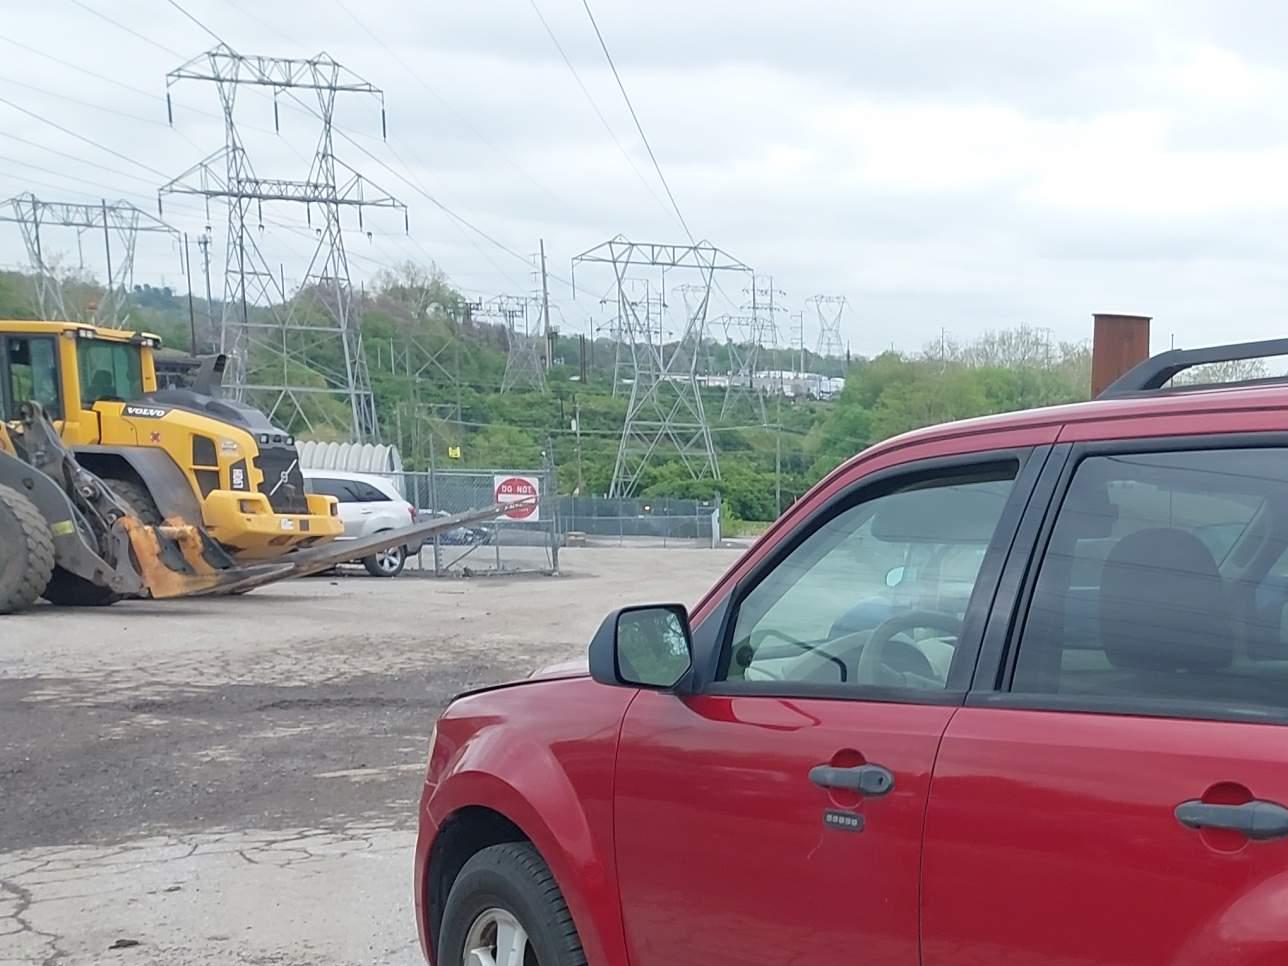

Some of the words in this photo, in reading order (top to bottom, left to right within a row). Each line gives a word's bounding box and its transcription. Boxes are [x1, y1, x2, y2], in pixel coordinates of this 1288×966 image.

[127, 406, 166, 417] VOLVO
[501, 485, 513, 493] DO
[516, 485, 532, 493] NOT
